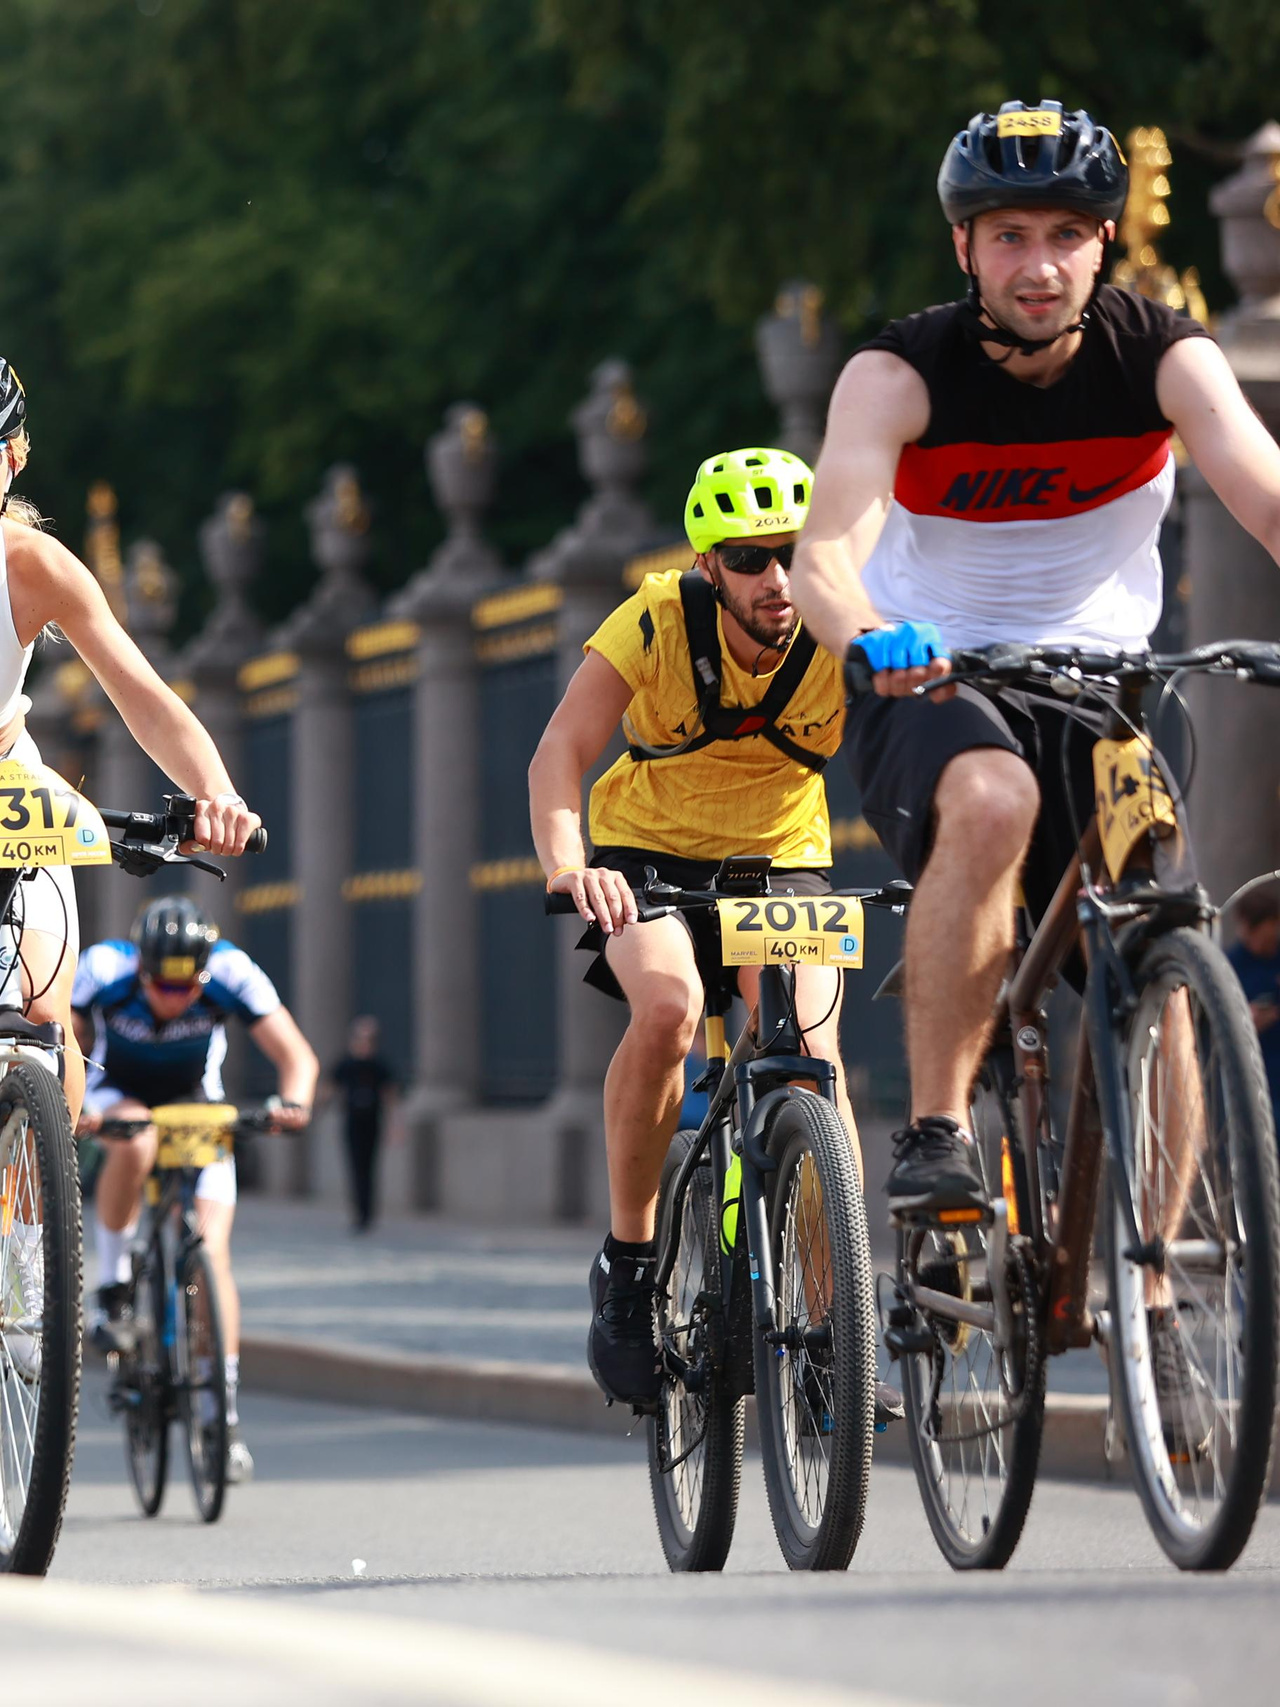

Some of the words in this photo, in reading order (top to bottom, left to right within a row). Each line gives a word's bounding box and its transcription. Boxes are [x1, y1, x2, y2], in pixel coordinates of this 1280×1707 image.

[938, 467, 1066, 511] NIKE
[755, 517, 790, 527] 2012
[82, 829, 95, 843] D
[2, 842, 31, 860] 40
[34, 845, 57, 856] KM
[734, 901, 849, 933] 2012
[770, 941, 797, 957] 40
[799, 946, 818, 955] KM
[844, 938, 855, 952] D
